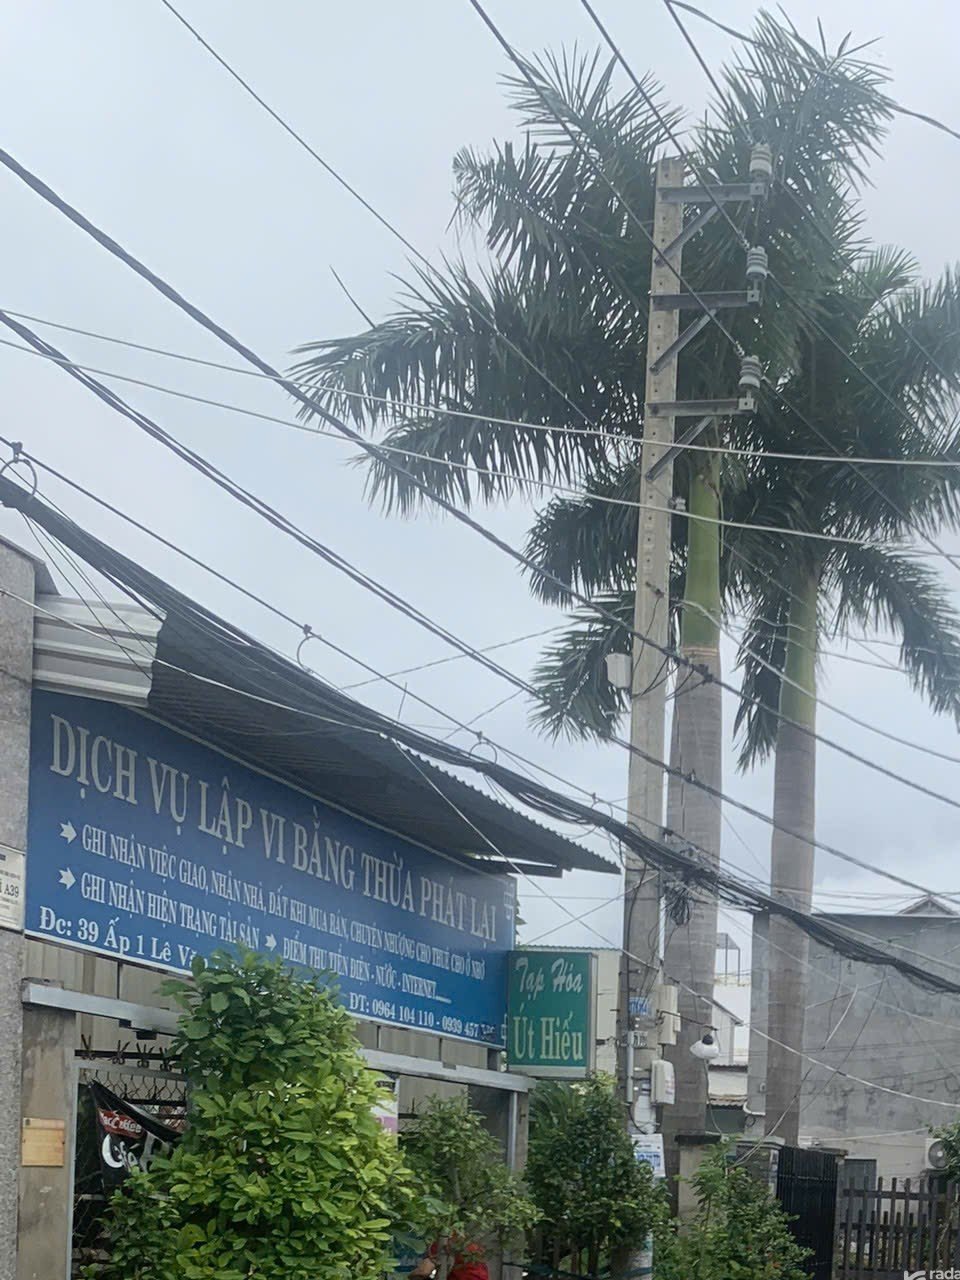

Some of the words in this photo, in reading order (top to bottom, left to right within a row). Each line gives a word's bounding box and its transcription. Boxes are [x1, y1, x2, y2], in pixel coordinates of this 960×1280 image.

[50, 714, 138, 805] DỊCH
[147, 757, 189, 836] VỤ
[198, 776, 253, 855] LẬP
[259, 808, 286, 864] VI
[292, 805, 356, 891] BẰNG
[361, 852, 415, 913] THỪA
[419, 876, 466, 931] PHÁT
[470, 897, 497, 949] LẠI
[81, 872, 106, 904] GHI
[108, 879, 145, 918] NHẬN
[147, 889, 177, 928] HIỆN
[180, 902, 217, 938] TRẠNG
[220, 911, 238, 944] TÀI
[82, 824, 107, 857] GHI
[109, 834, 146, 873] NHẬN
[149, 844, 177, 884] VIỆC
[179, 858, 209, 896] GIAO,
[211, 870, 241, 907] NHẬN
[290, 900, 307, 926] KHI
[308, 905, 328, 932] MUA
[416, 942, 431, 965] CHO
[451, 953, 465, 975] CHO
[39, 906, 72, 937] Đc:
[77, 918, 99, 943] 39
[104, 917, 130, 955] Ấp
[136, 935, 145, 956] 1
[151, 937, 172, 962] Lê
[308, 945, 328, 971] THU
[375, 962, 397, 990] NƯỚC
[515, 957, 545, 1000] Tạp
[551, 958, 584, 993] Hóa
[349, 992, 370, 1014] ĐT:
[372, 999, 396, 1019] 0964
[399, 1006, 415, 1024] 104
[418, 1010, 434, 1027] 110
[442, 1015, 463, 1034] 0939
[513, 1002, 535, 1059] Út
[540, 1010, 584, 1061] Hiếu
